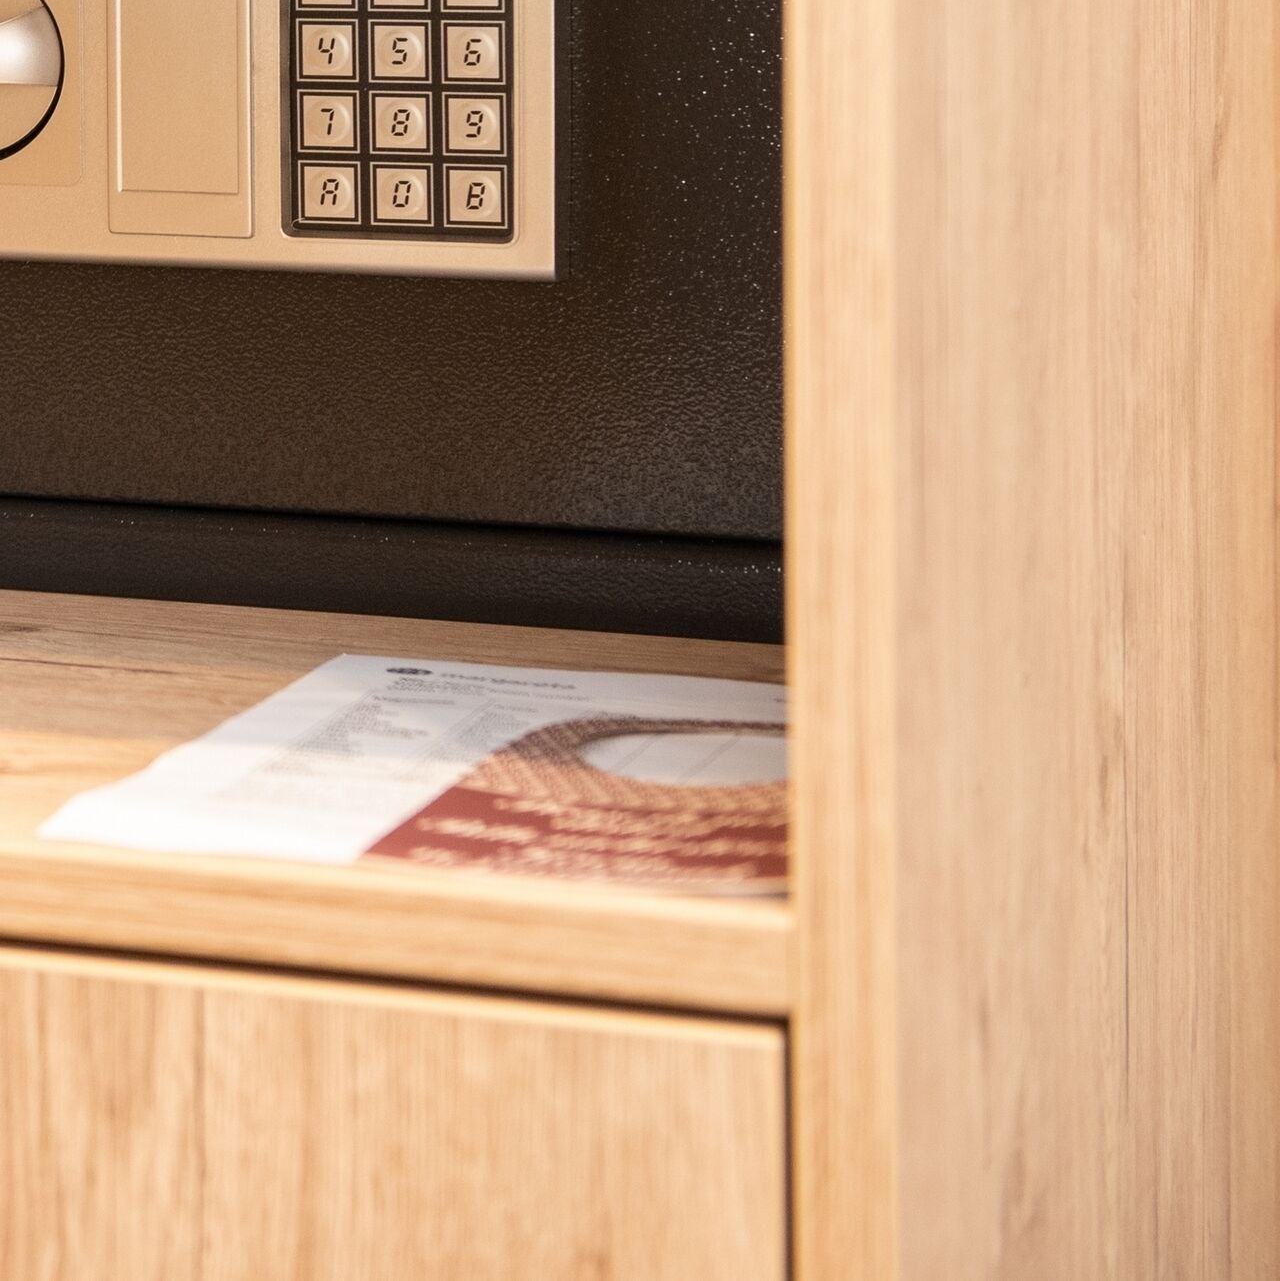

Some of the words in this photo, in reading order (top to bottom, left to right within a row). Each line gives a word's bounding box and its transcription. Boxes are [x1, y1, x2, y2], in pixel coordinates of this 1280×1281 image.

[317, 37, 336, 65] 4
[391, 37, 409, 65] 5
[463, 38, 482, 67] 6
[320, 108, 335, 136] 7
[391, 108, 411, 137] 8
[465, 110, 484, 138] 9
[319, 178, 340, 206] A
[392, 180, 412, 208] 0
[465, 182, 486, 210] B
